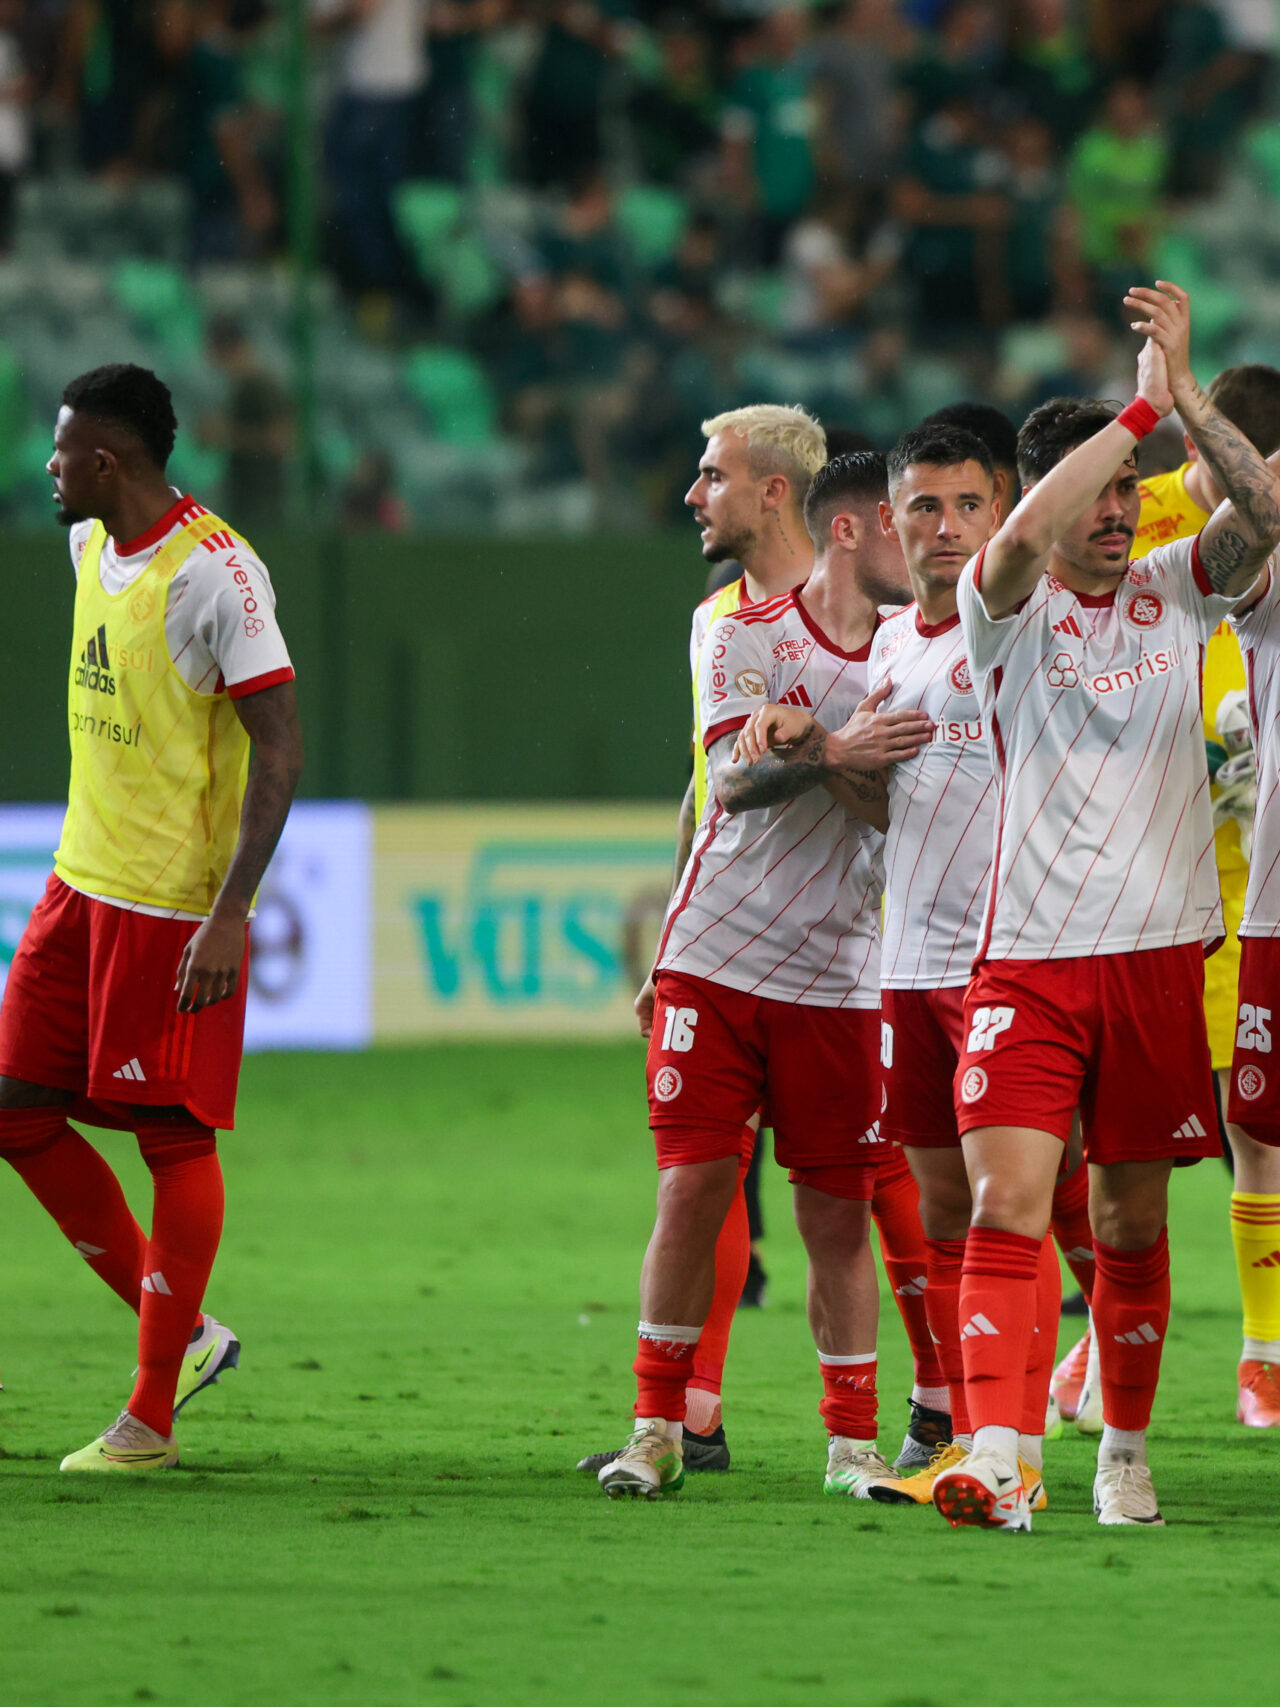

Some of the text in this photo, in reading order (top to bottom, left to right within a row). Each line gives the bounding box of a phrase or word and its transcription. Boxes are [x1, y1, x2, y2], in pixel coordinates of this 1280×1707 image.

[225, 555, 258, 613] vero
[772, 637, 811, 659] STRELA
[788, 649, 806, 662] BET
[711, 644, 728, 703] vero
[661, 1006, 698, 1052] 16
[966, 1006, 1016, 1053] 27
[1236, 1003, 1272, 1053] 25
